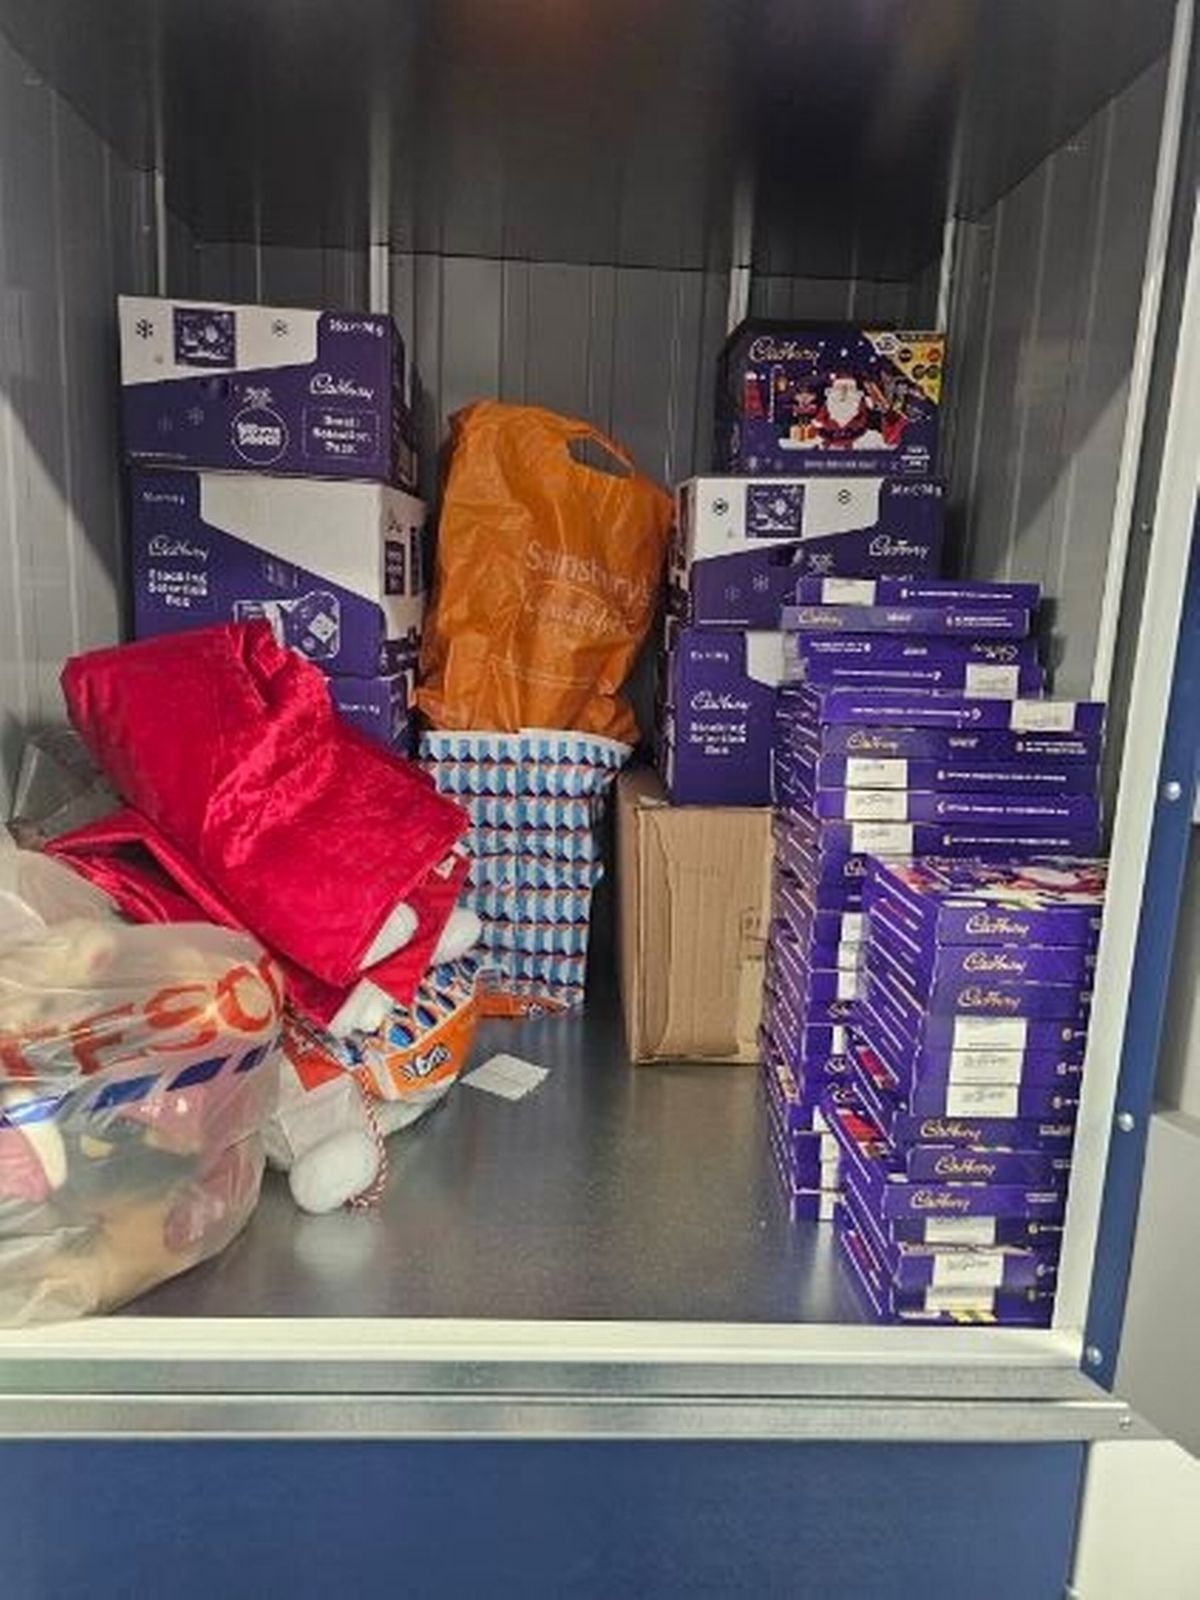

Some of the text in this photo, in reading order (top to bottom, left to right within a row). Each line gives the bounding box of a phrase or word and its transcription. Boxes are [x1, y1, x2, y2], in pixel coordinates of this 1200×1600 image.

[309, 372, 375, 400] Cadbury
[149, 534, 210, 561] Cadbury
[690, 690, 752, 715] Cadbury
[846, 731, 899, 753] Cadbury
[964, 911, 1030, 938] Cadbury
[962, 951, 1028, 976] Cadbury
[957, 987, 1021, 1013] Cadbury
[919, 1119, 982, 1142] Cadbury
[933, 1153, 996, 1177] Cadbury
[910, 1189, 971, 1211] Cadbury
